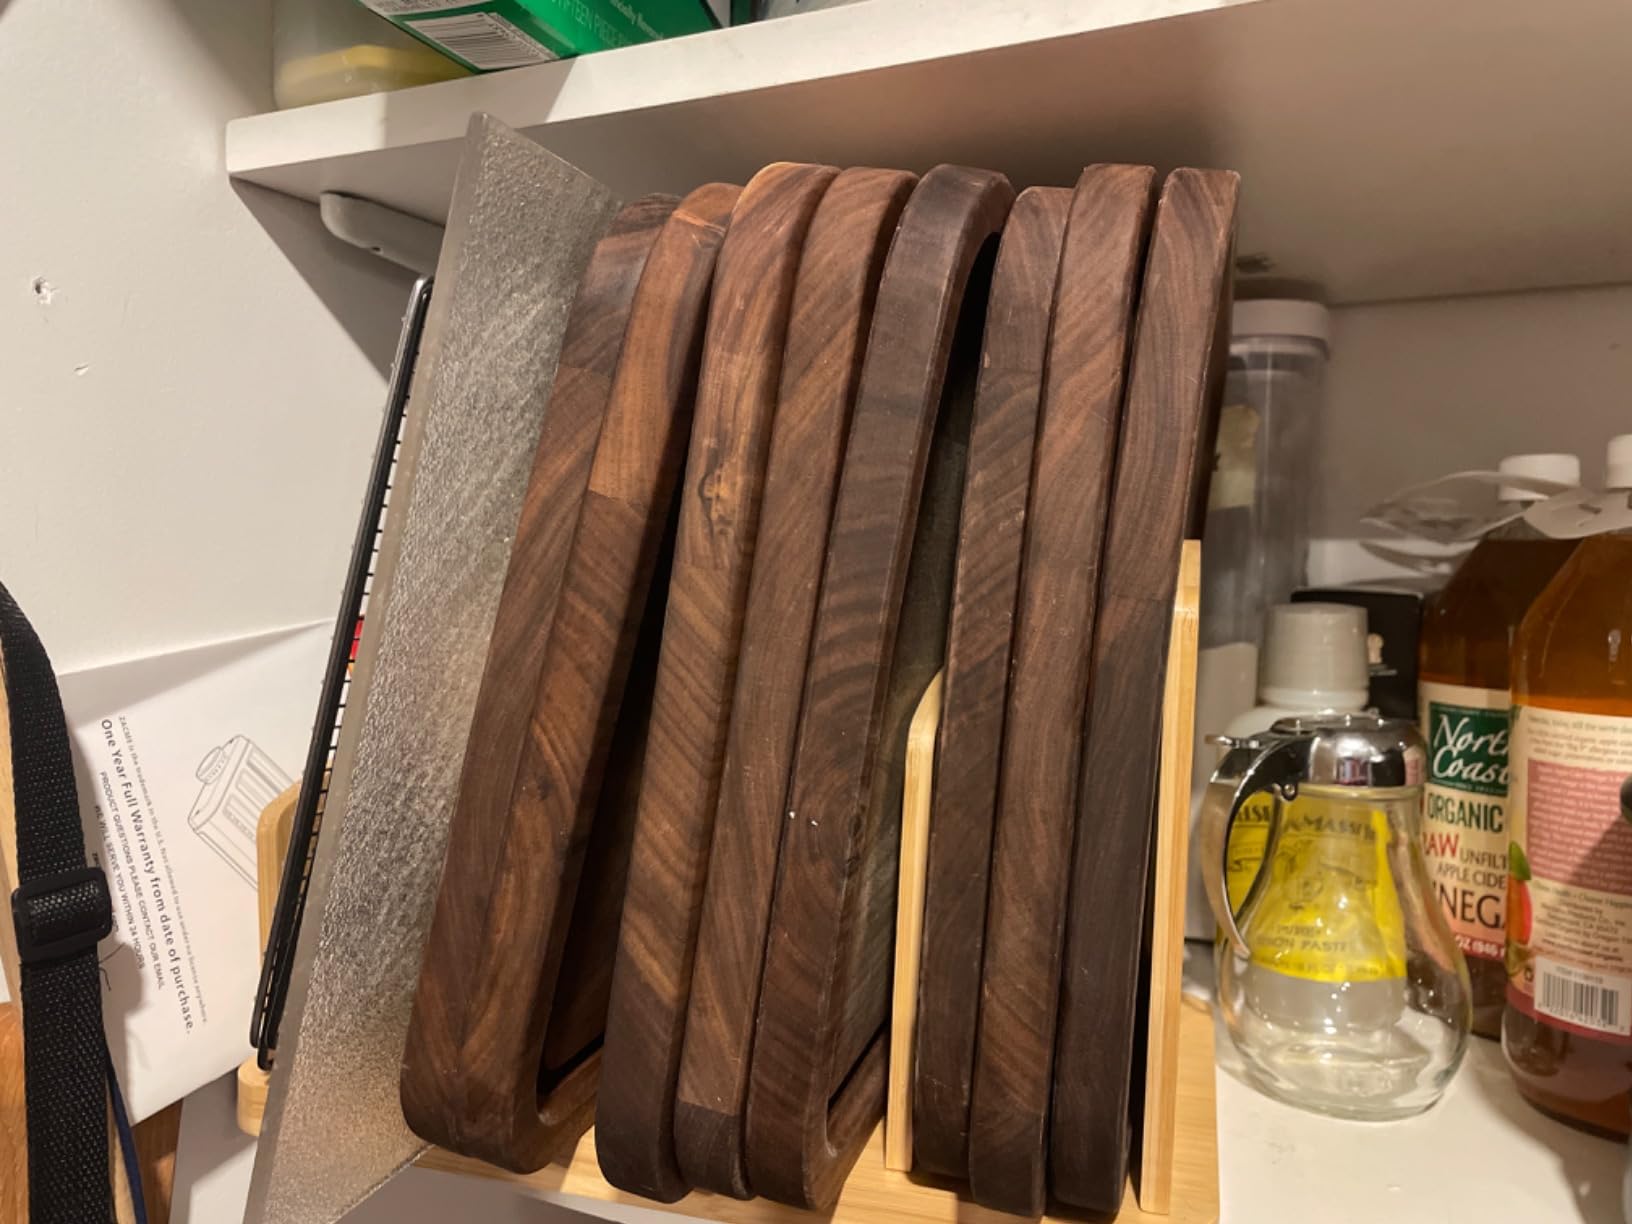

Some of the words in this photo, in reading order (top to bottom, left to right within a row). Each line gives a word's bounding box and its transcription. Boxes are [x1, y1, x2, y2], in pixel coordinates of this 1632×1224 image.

[101, 718, 116, 747] One
[111, 749, 127, 780] Year
[99, 770, 118, 813] PRODUCT
[121, 781, 138, 808] Full
[1426, 791, 1503, 833] ORGANIC
[112, 813, 133, 864] QUESTIONS
[131, 809, 155, 875] Warranty
[127, 864, 143, 898] PLEASE
[1436, 862, 1470, 882] APPLE
[98, 819, 110, 842] WILL
[105, 841, 121, 872] SERVE
[115, 872, 126, 892] YOU
[121, 892, 135, 924] WITHIN
[134, 937, 146, 969] HOURS
[150, 876, 166, 912] from
[138, 899, 154, 940] CONTACT
[160, 913, 174, 945] date
[148, 942, 160, 961] OUR
[167, 947, 181, 962] of
[152, 962, 166, 990] EMAIL
[171, 965, 195, 1035] purchase.
